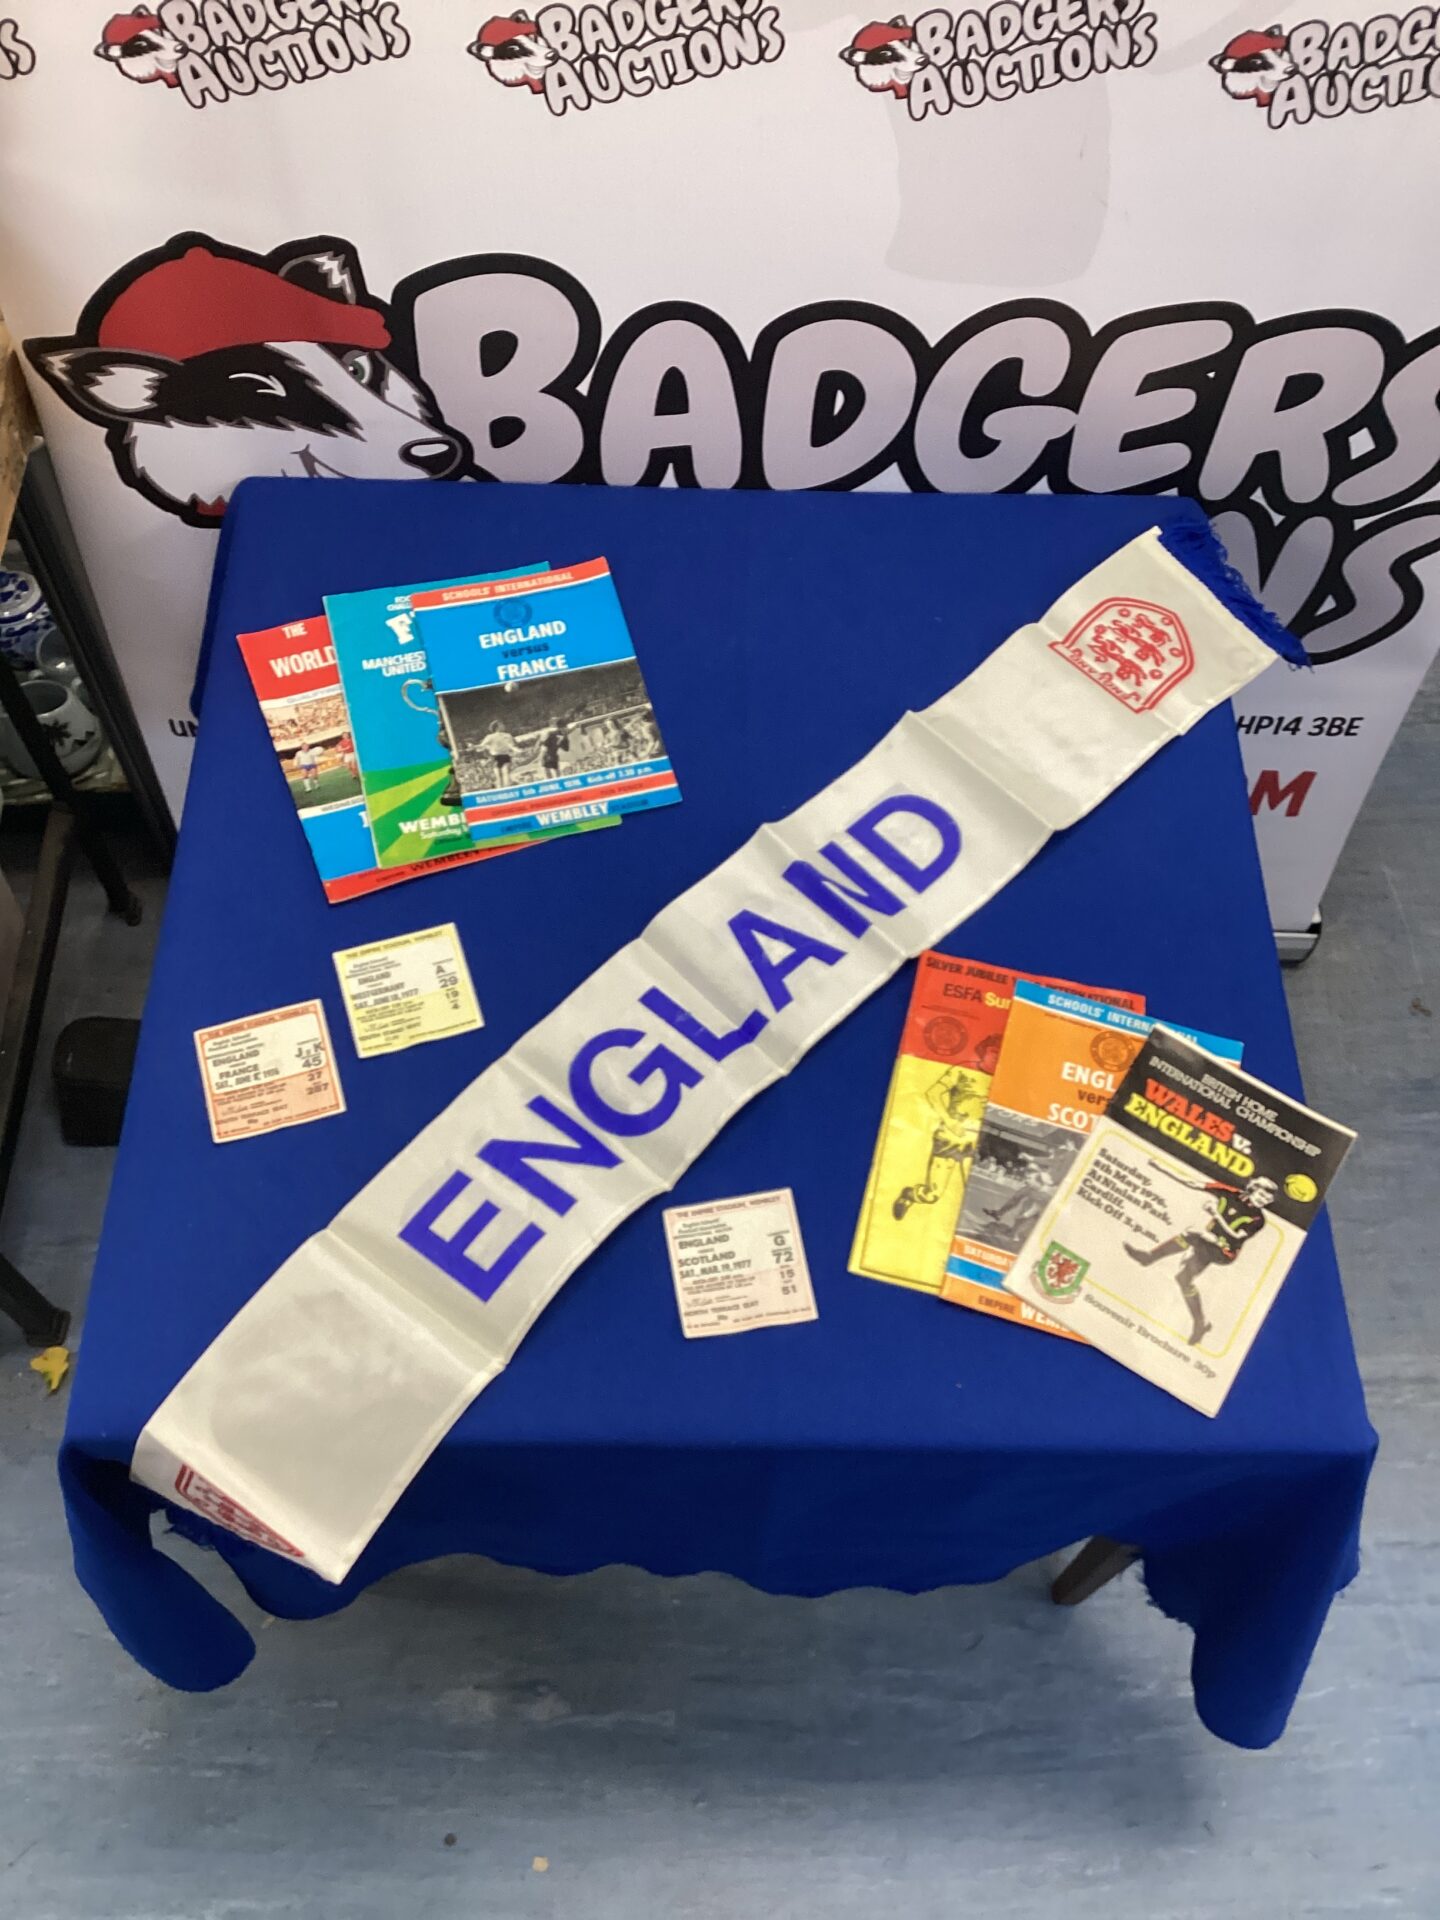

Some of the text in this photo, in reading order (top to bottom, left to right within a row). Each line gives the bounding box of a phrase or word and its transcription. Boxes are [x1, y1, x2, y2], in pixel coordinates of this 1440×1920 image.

[177, 1, 411, 109] AUCTIONS
[1287, 6, 1440, 78] BADG
[545, 6, 785, 116] AUCTIONS
[907, 12, 1158, 121] AUCTIONS
[1267, 54, 1440, 129] AUCTI
[494, 571, 575, 594] INTERNATIONAL
[281, 621, 308, 640] THE
[478, 619, 568, 650] ENGLAND
[268, 645, 338, 679] WORLD
[361, 650, 427, 670] MANCHES
[502, 641, 550, 660] versus
[382, 660, 427, 679] UNITED
[496, 653, 569, 681] FRANCE
[1236, 716, 1364, 737] HP14 3BE
[398, 811, 466, 834] WEMB
[535, 802, 610, 826] WEMBLEY
[926, 957, 963, 974] SILVER
[965, 966, 1009, 985] JUBILEE
[943, 983, 983, 1004] ESFA
[398, 794, 962, 1303] ENGLAND
[1061, 1061, 1117, 1093] ENGL
[1144, 1078, 1236, 1143] WALES
[1149, 1055, 1322, 1157] INTERNATIONAL CHAMPIONSHIP
[1202, 1073, 1279, 1122] BRITISH HOME
[1123, 1092, 1256, 1179] ENGLAND
[1098, 1147, 1152, 1187] Saturday,
[1113, 1169, 1141, 1193] May
[1076, 1185, 1103, 1209] Kick
[1103, 1203, 1125, 1220] Off
[678, 1233, 731, 1251] ENGLAND
[773, 1234, 787, 1247] G
[677, 1250, 737, 1268] SCOTLAND
[771, 1250, 795, 1265] 72
[1083, 1293, 1136, 1329] Souvenir
[1136, 1324, 1192, 1363] Brochure
